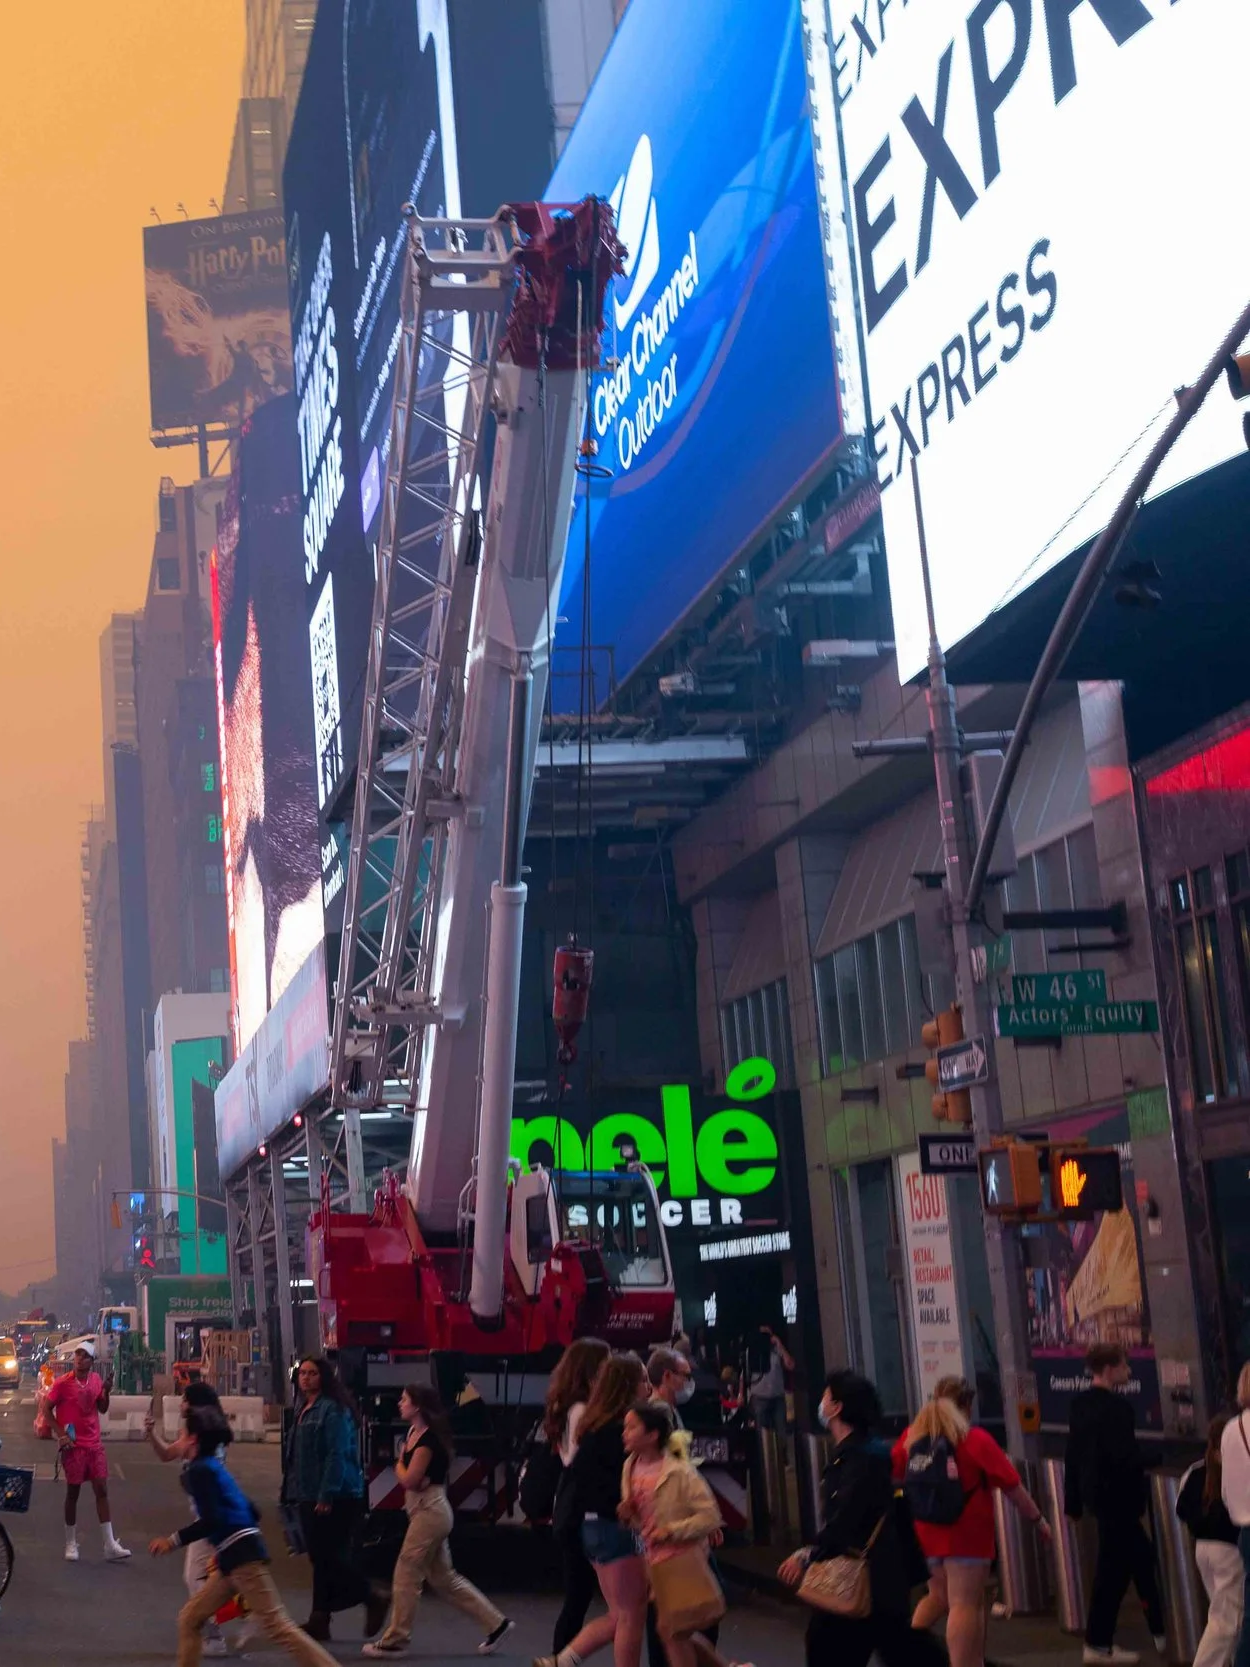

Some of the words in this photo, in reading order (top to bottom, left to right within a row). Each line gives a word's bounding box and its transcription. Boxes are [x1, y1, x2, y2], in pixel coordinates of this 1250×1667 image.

[222, 216, 286, 234] BROADW
[250, 235, 287, 272] Pot
[594, 351, 631, 437] Clear
[631, 230, 699, 377] Channel
[871, 236, 1059, 493] EXPRESS
[297, 305, 339, 497] TIMES
[618, 352, 678, 470] Outdoor
[304, 415, 345, 585] SQUARE
[1017, 979, 1037, 1003] W
[1049, 973, 1078, 1002] 46
[1008, 1004, 1074, 1025] Actors'
[1084, 1004, 1144, 1026] Equity
[965, 1052, 981, 1070] WAY
[905, 1172, 942, 1223] 1560
[915, 1264, 952, 1285] RESTAURANT
[169, 1297, 199, 1310] Ship
[202, 1297, 234, 1310] freig
[917, 1286, 936, 1305] SPACE
[919, 1307, 951, 1325] AVAILABLE
